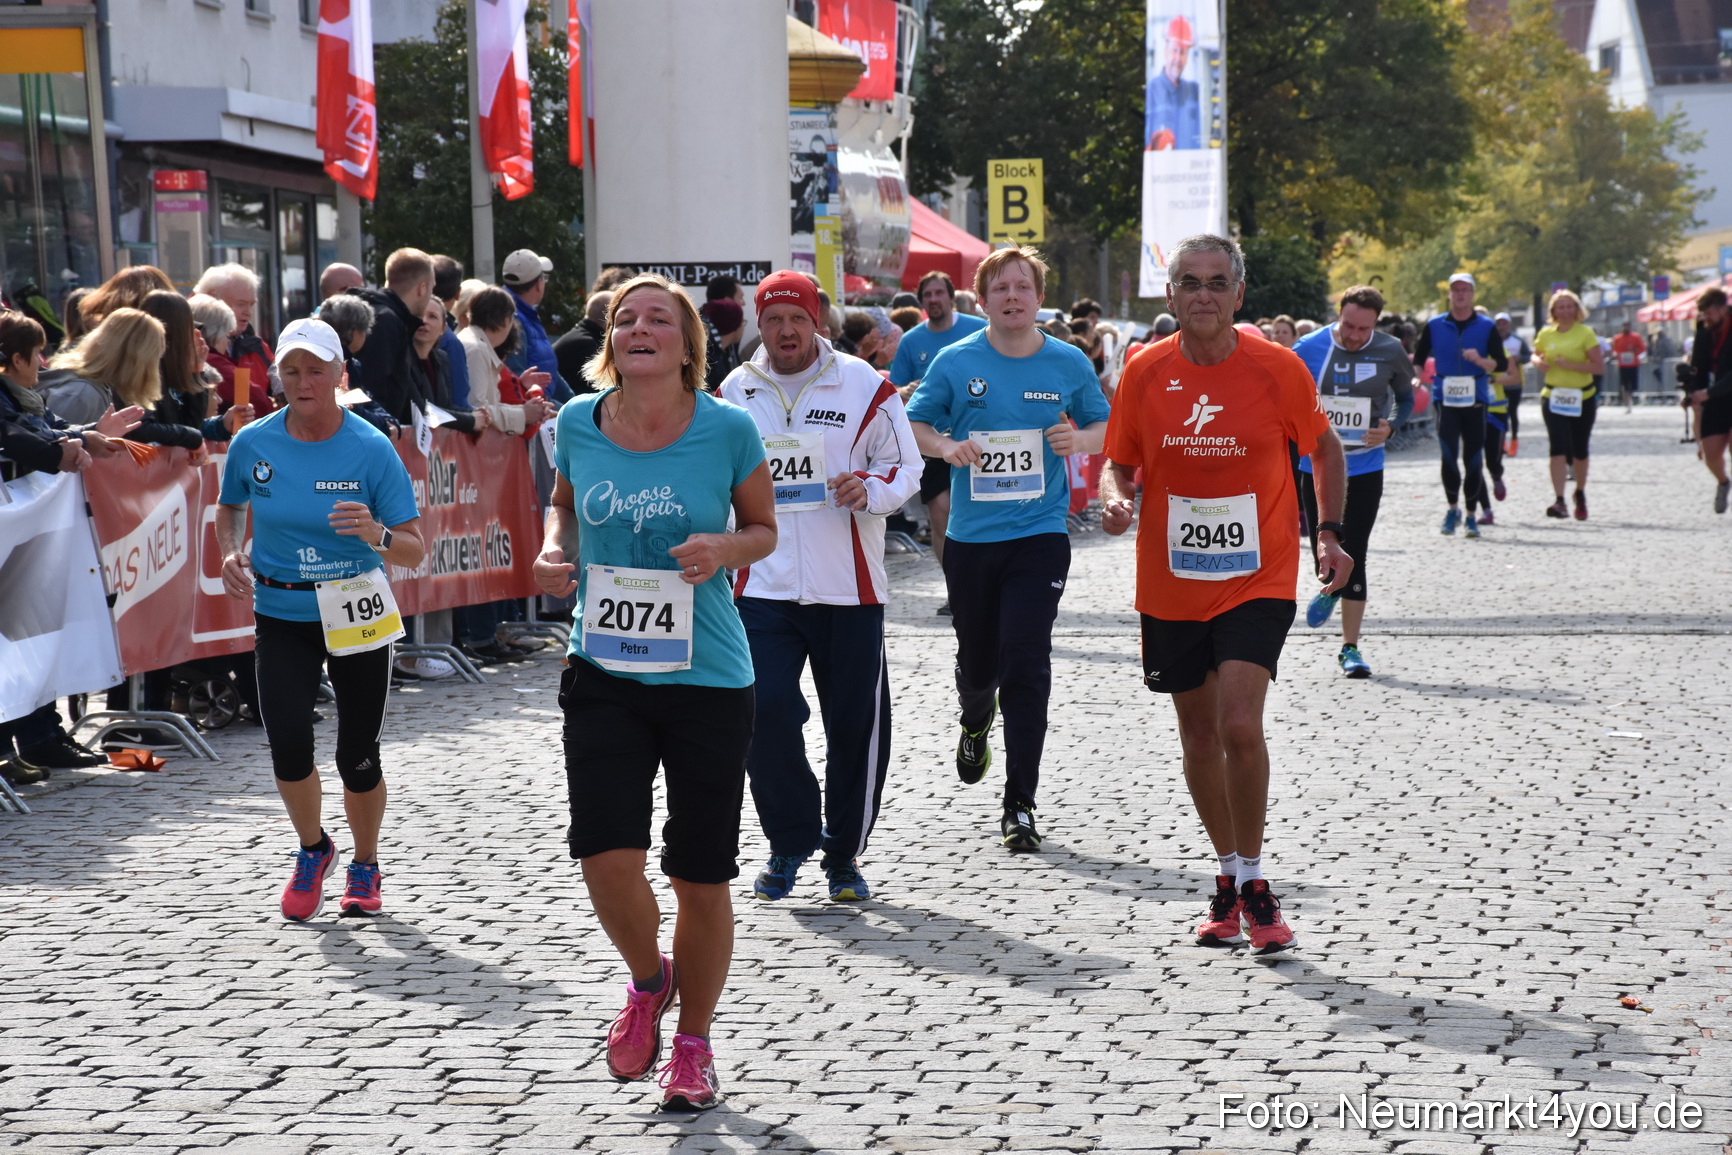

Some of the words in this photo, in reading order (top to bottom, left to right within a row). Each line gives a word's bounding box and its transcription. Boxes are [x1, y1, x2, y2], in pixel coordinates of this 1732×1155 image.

[994, 162, 1036, 178] Block
[1003, 185, 1030, 225] B
[817, 228, 834, 246] 18.
[772, 290, 800, 298] odlo
[1023, 391, 1060, 401] BOCK
[1448, 386, 1470, 395] 2021
[804, 419, 844, 429] SPORT-Service
[806, 409, 846, 423] JURA
[1326, 410, 1363, 426] 2010
[1162, 434, 1237, 448] funrunners
[1183, 445, 1248, 457] neumarkt
[769, 455, 814, 481] 244
[980, 450, 1032, 473] 2213
[315, 481, 360, 490] BOCK
[996, 479, 1019, 488] André
[582, 480, 675, 526] Choose
[632, 502, 686, 534] your
[1180, 521, 1245, 549] 2949
[146, 507, 181, 581] NEUE
[485, 520, 513, 570] Hits
[297, 547, 322, 563] 18.
[1181, 553, 1249, 570] ERNST
[299, 560, 353, 571] Neumarkter
[622, 577, 659, 588] BOCK
[341, 593, 385, 623] 199
[597, 598, 675, 633] 2074
[361, 628, 377, 639] Eva
[620, 641, 649, 655] Petra
